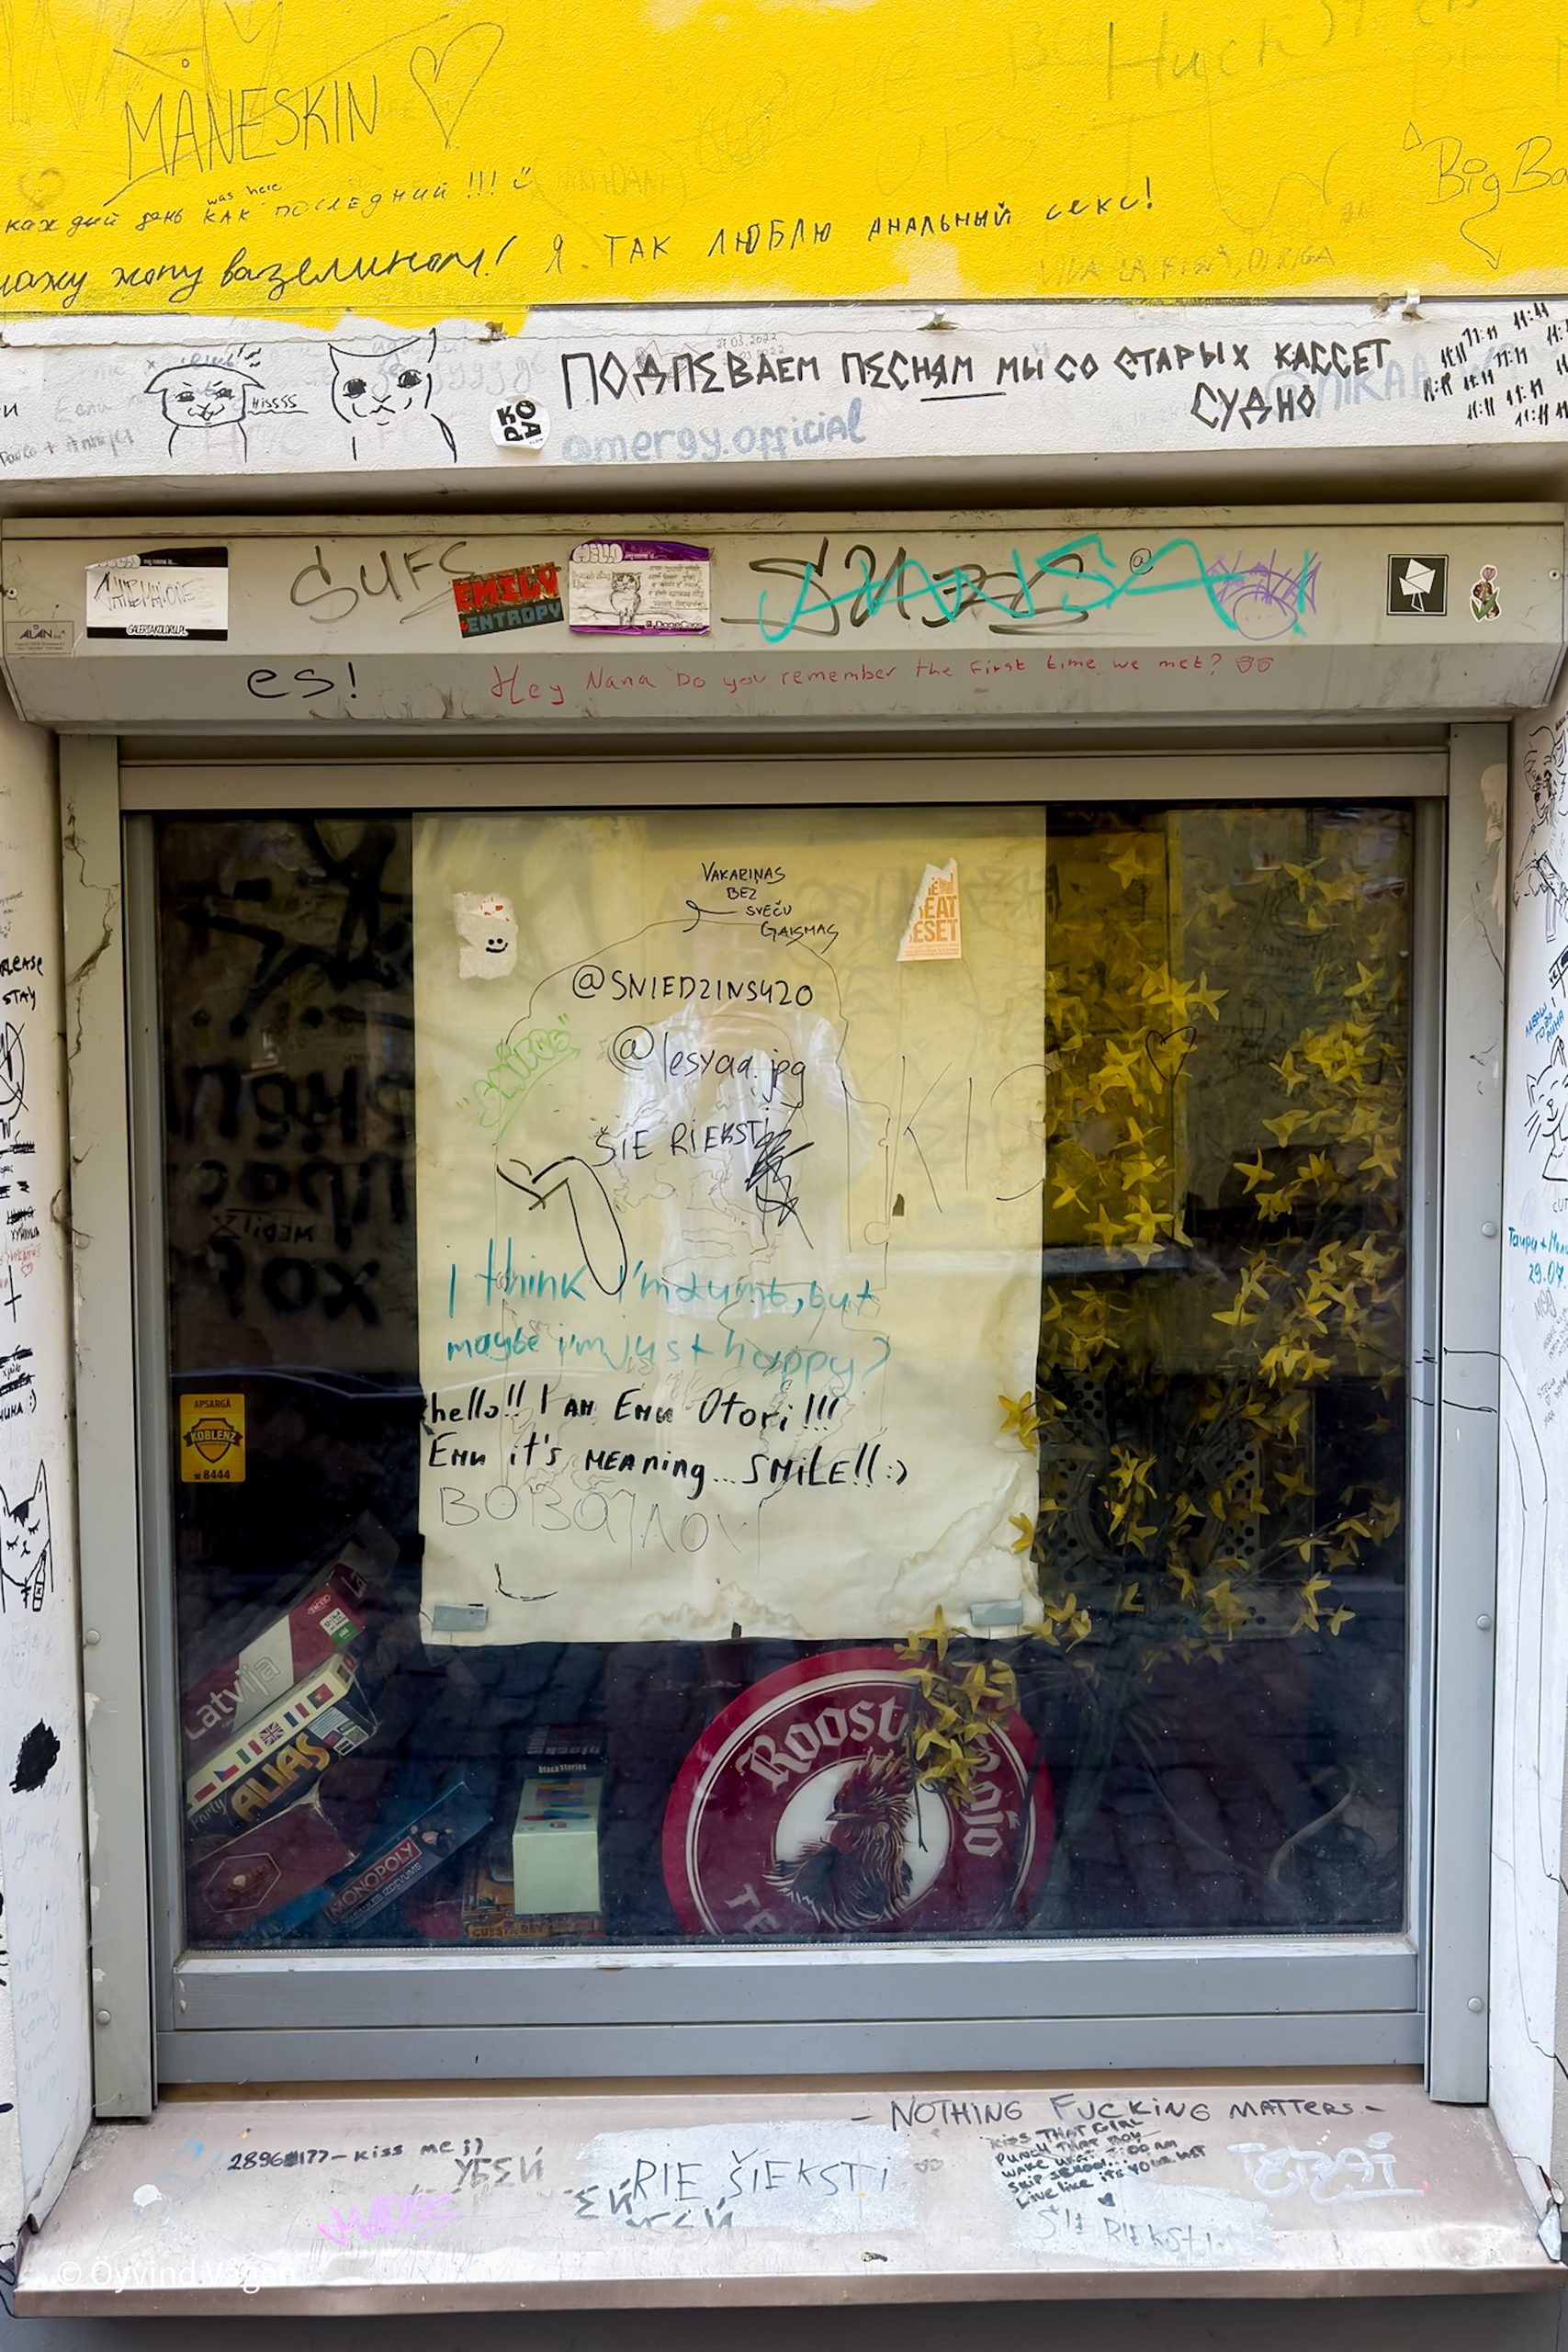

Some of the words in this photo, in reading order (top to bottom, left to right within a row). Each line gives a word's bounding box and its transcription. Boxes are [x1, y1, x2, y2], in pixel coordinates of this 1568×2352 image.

[207, 190, 233, 208] was
[246, 181, 283, 197] here
[603, 233, 671, 270] ТАК
[708, 219, 833, 258] ЛЮБЛЮ
[997, 355, 1043, 385] МЫ
[1054, 352, 1100, 383] СО
[1112, 342, 1250, 381] СТАРЫХ
[1273, 338, 1392, 379] КАССЕТ
[1190, 381, 1316, 432] СУДНО
[453, 565, 558, 610] EMILY
[468, 602, 561, 633] ENTROPY
[491, 665, 565, 705] Hey
[586, 667, 656, 689] Nana
[723, 675, 766, 693] you
[782, 665, 897, 686] remember
[916, 659, 953, 678] the
[1047, 656, 1097, 671] time
[1112, 659, 1139, 671] we
[727, 887, 757, 900] BEZ
[909, 919, 958, 943] ESET
[476, 1237, 587, 1306] think
[809, 1279, 880, 1309] but
[447, 1326, 539, 1363] maybe
[541, 1384, 548, 1414] I
[190, 1430, 237, 1442] KOBLENZ
[510, 1431, 563, 1466] it's
[203, 1470, 231, 1480] 8444
[186, 1656, 280, 1740] Latvija
[736, 1695, 909, 1793] Roost
[231, 1732, 331, 1822] ALIAS
[327, 1841, 413, 1917] MONOPOLY
[891, 2098, 1022, 2131] NOTHING
[420, 2141, 455, 2155] me
[632, 2158, 704, 2201] RIE
